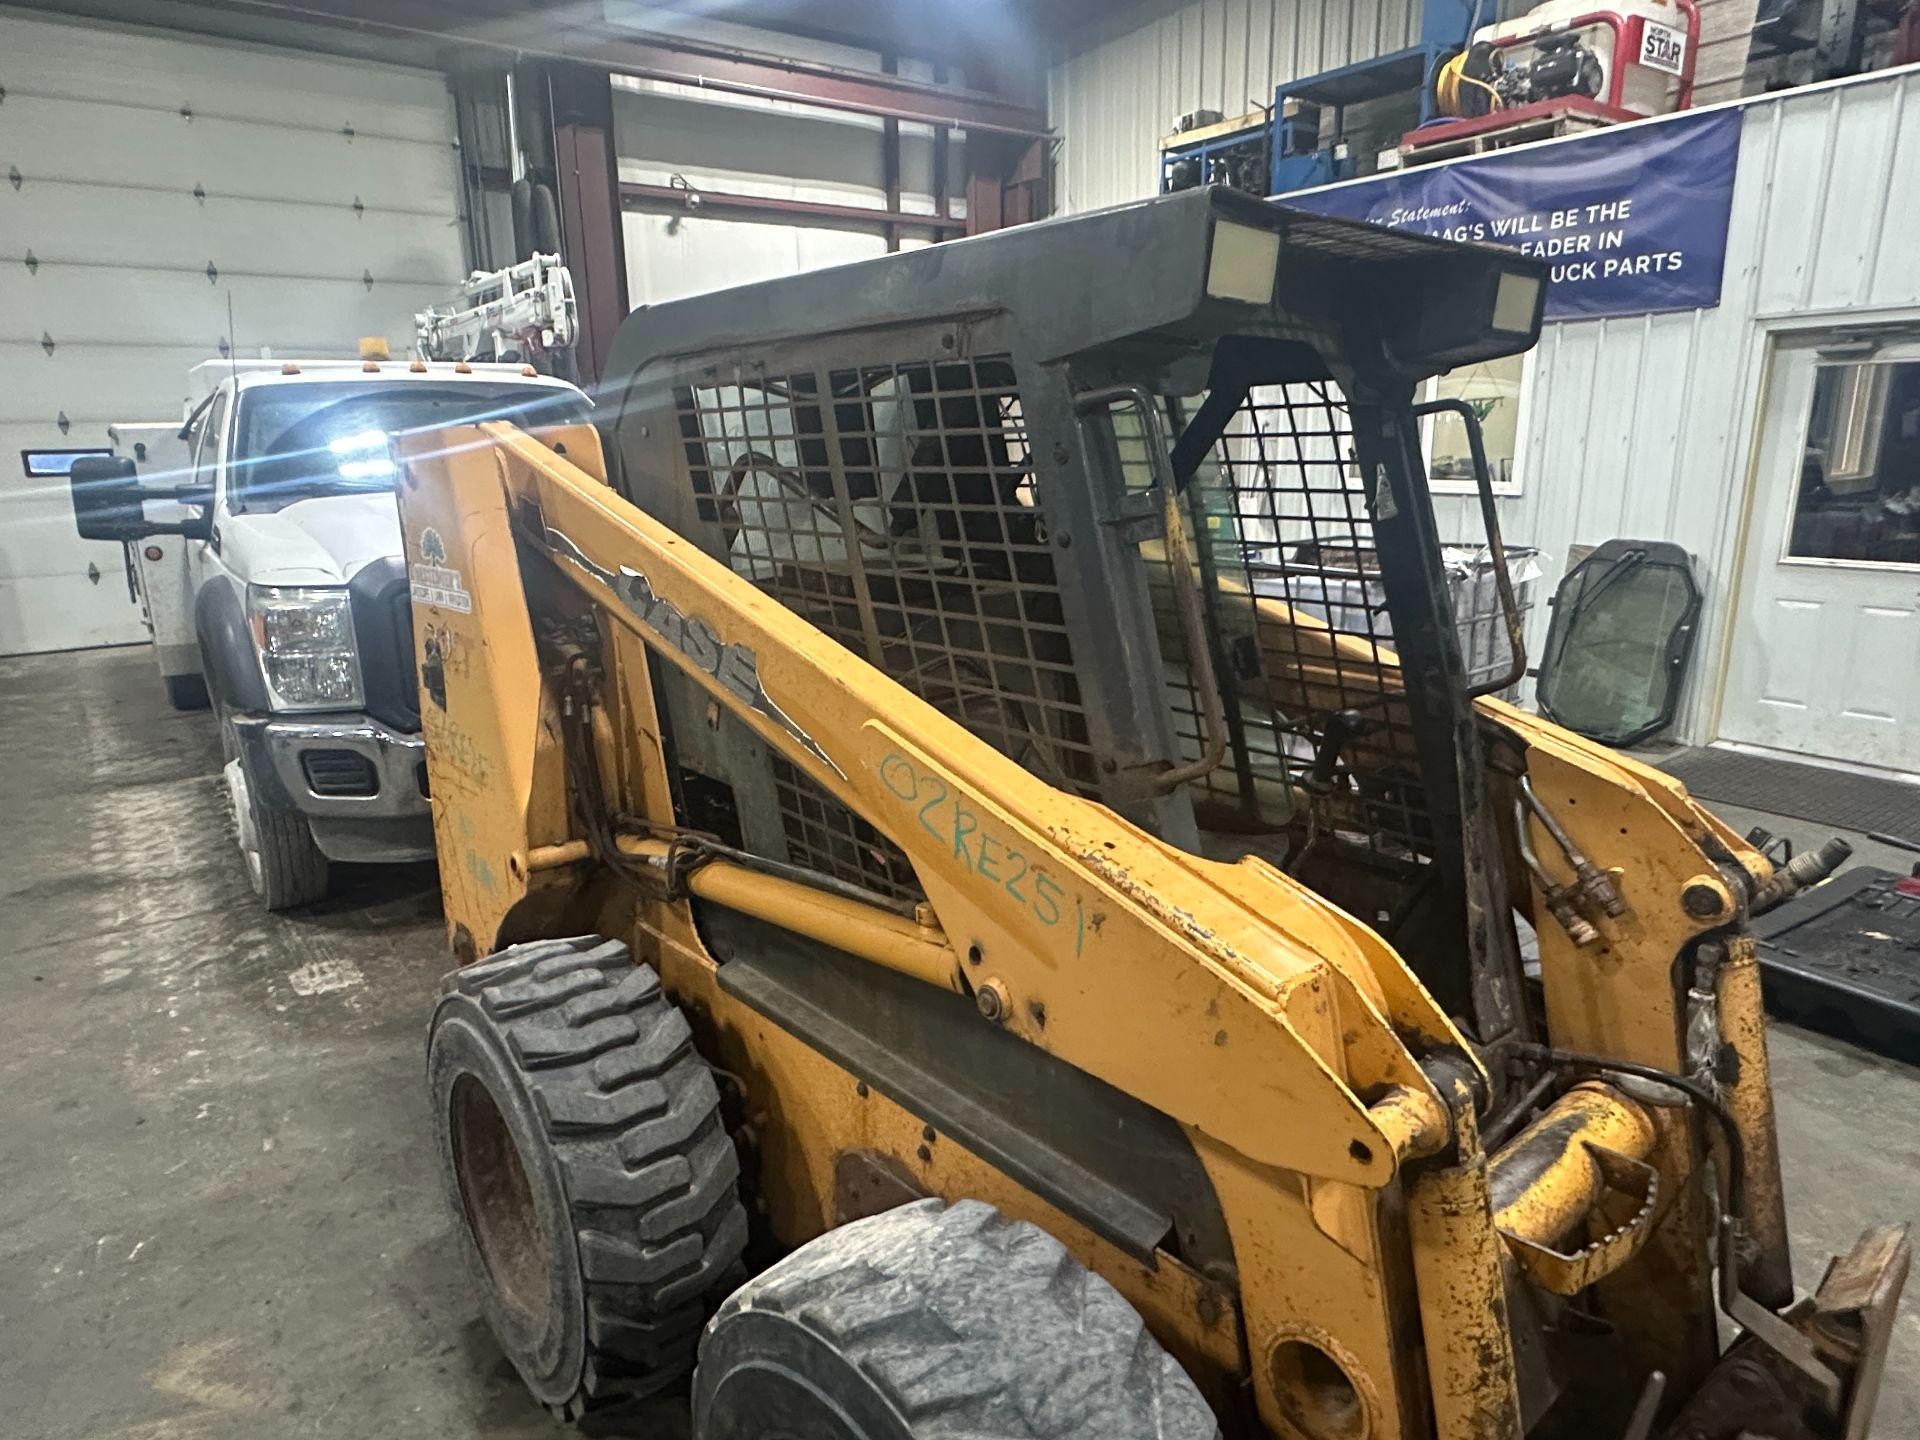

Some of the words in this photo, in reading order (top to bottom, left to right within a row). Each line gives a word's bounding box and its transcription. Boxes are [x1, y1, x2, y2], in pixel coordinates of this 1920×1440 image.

[1645, 34, 1681, 63] STAR
[1491, 216, 1543, 237] WILL
[1550, 208, 1580, 230] BE
[1585, 200, 1632, 224] THE
[1598, 230, 1624, 250] IN
[1551, 261, 1597, 283] UCK
[1604, 251, 1682, 278] PARTS
